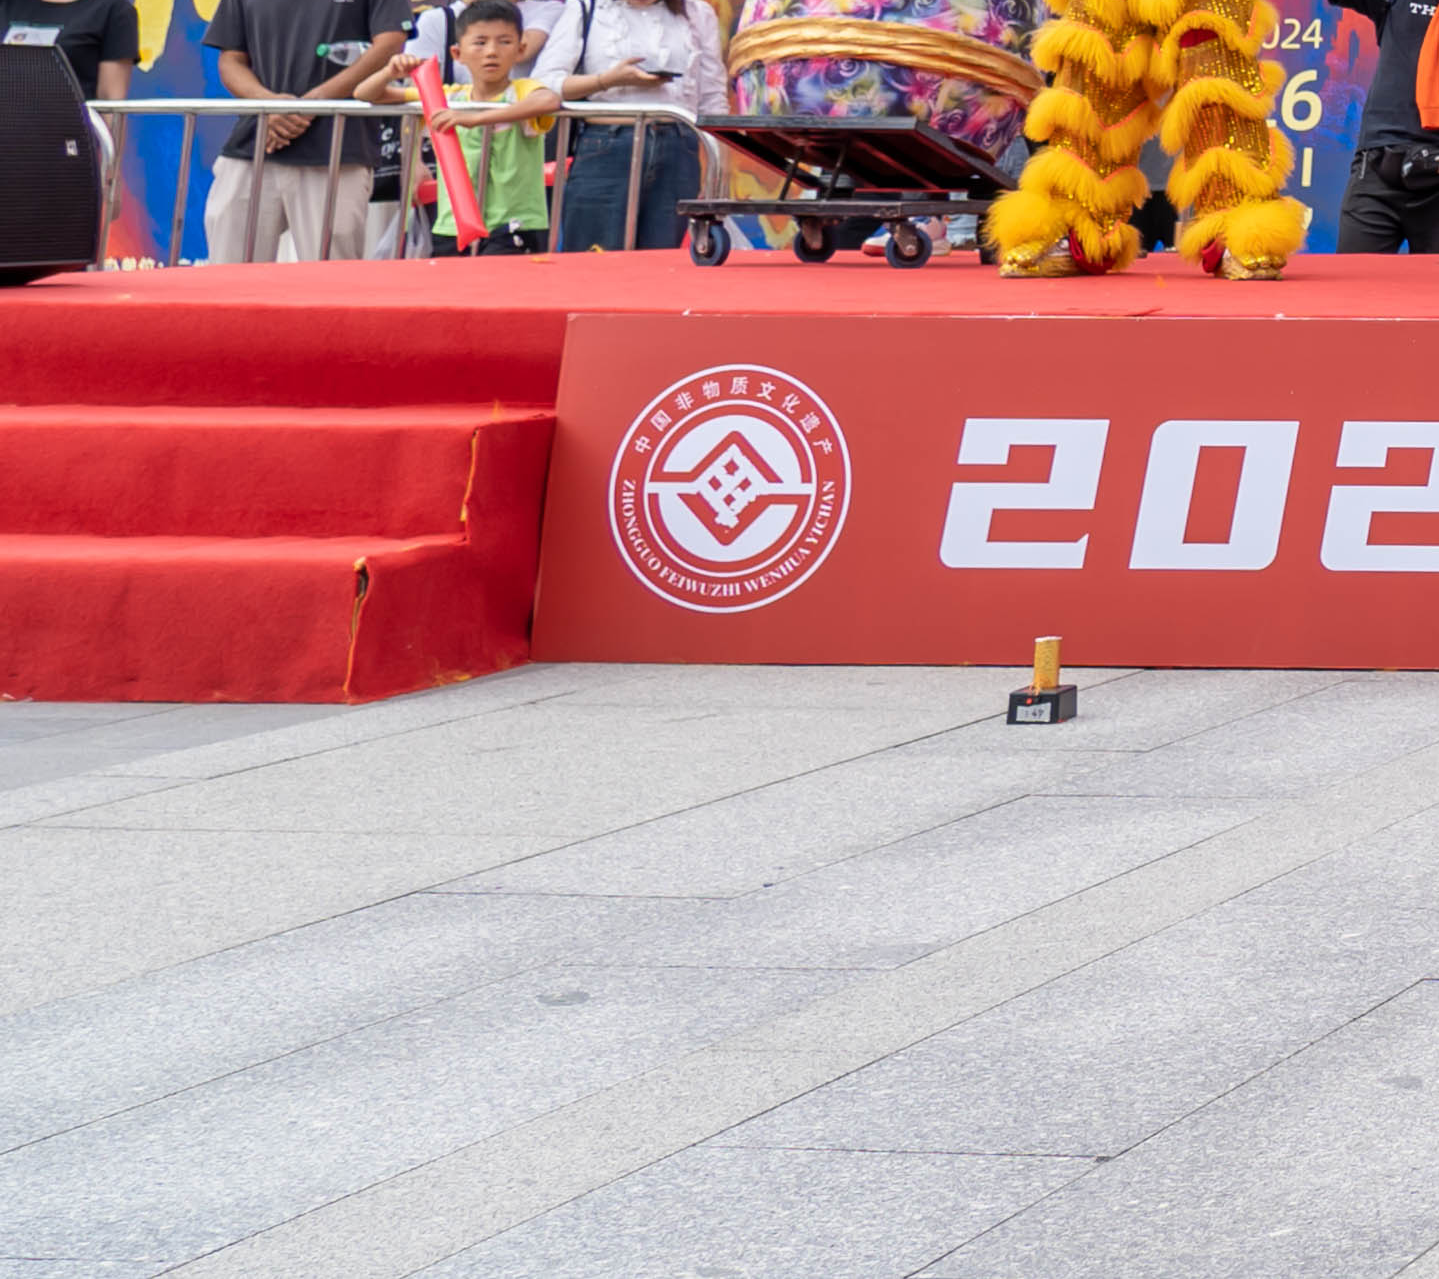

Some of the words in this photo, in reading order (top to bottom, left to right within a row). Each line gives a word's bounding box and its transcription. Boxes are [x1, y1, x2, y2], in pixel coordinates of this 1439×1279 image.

[635, 375, 834, 456] 中国非物质文化遗产
[621, 478, 662, 572] ZHONGGUO
[659, 566, 741, 598] FEIWUZHI
[743, 547, 812, 593] WENHUA
[805, 479, 836, 546] YICHAN
